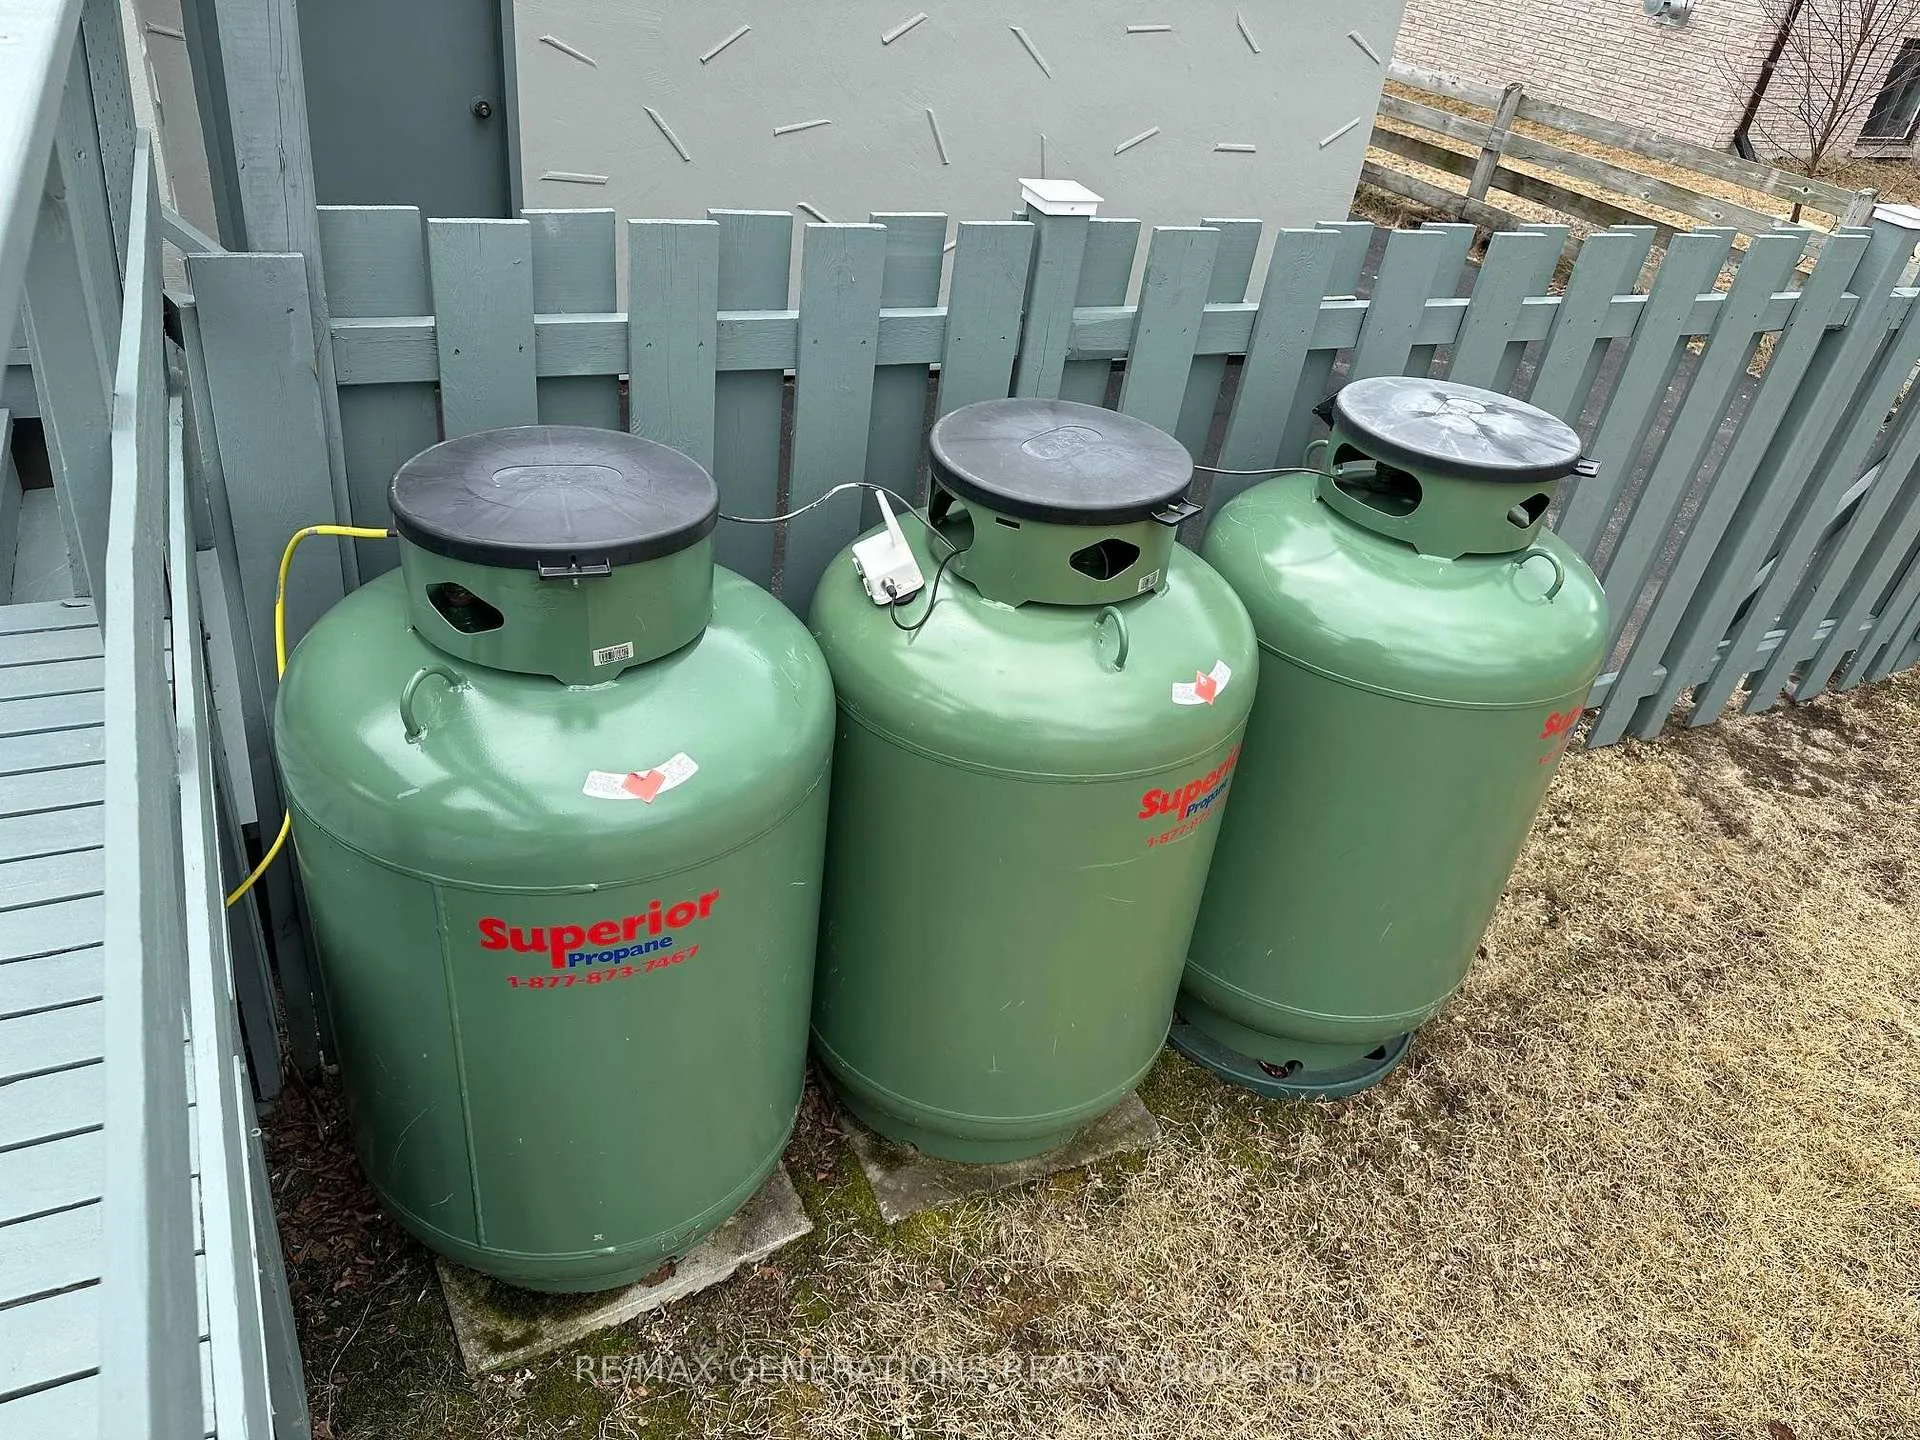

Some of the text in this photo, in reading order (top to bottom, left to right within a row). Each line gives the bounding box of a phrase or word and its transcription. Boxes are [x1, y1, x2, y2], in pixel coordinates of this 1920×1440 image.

[478, 889, 720, 969] Superior
[568, 935, 673, 967] Propane
[507, 945, 699, 989] 1-877-873-7467
